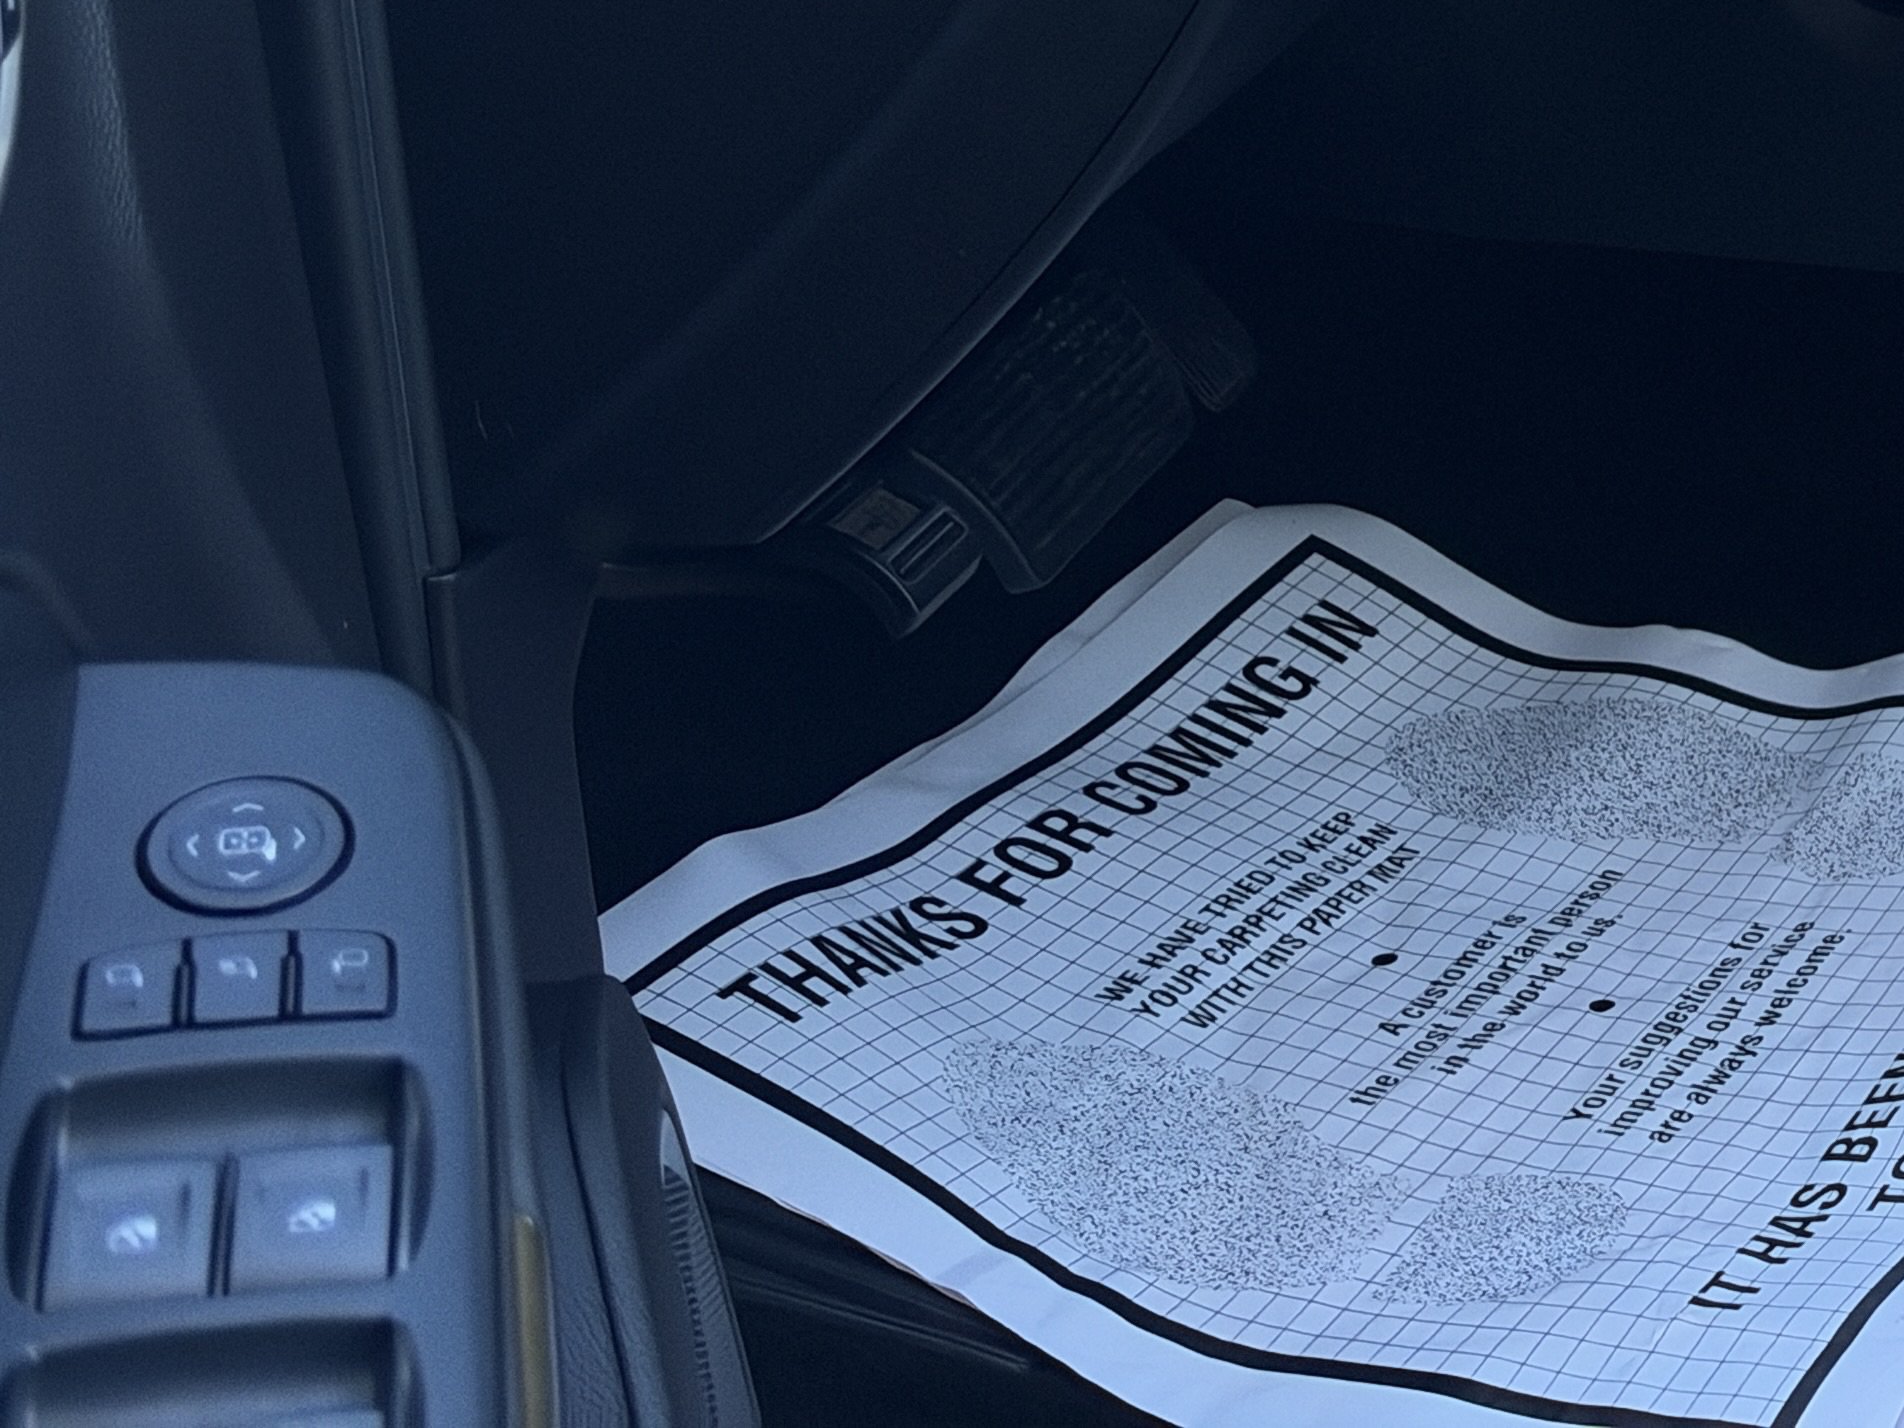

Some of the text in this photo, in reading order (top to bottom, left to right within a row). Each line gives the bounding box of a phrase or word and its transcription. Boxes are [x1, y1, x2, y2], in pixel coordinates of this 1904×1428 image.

[717, 599, 1380, 1022] THANKS FOR COMING IN
[1097, 810, 1360, 1005] WE HAVE TRIED TO KEEP
[1135, 822, 1397, 1021] YOUR CARPETING CLEAN
[1182, 841, 1423, 1032] WITH THIS PAPER MAT
[1349, 868, 1623, 1109] the most important person
[1377, 909, 1529, 1037] A customer is
[1431, 909, 1624, 1076] in the world to us.
[1568, 918, 1772, 1123] Your suggestions for
[1598, 918, 1816, 1141] improving our service
[1649, 926, 1852, 1146] are always welcome.
[1688, 1269, 1762, 1313] IT
[1737, 1180, 1848, 1265] HAS
